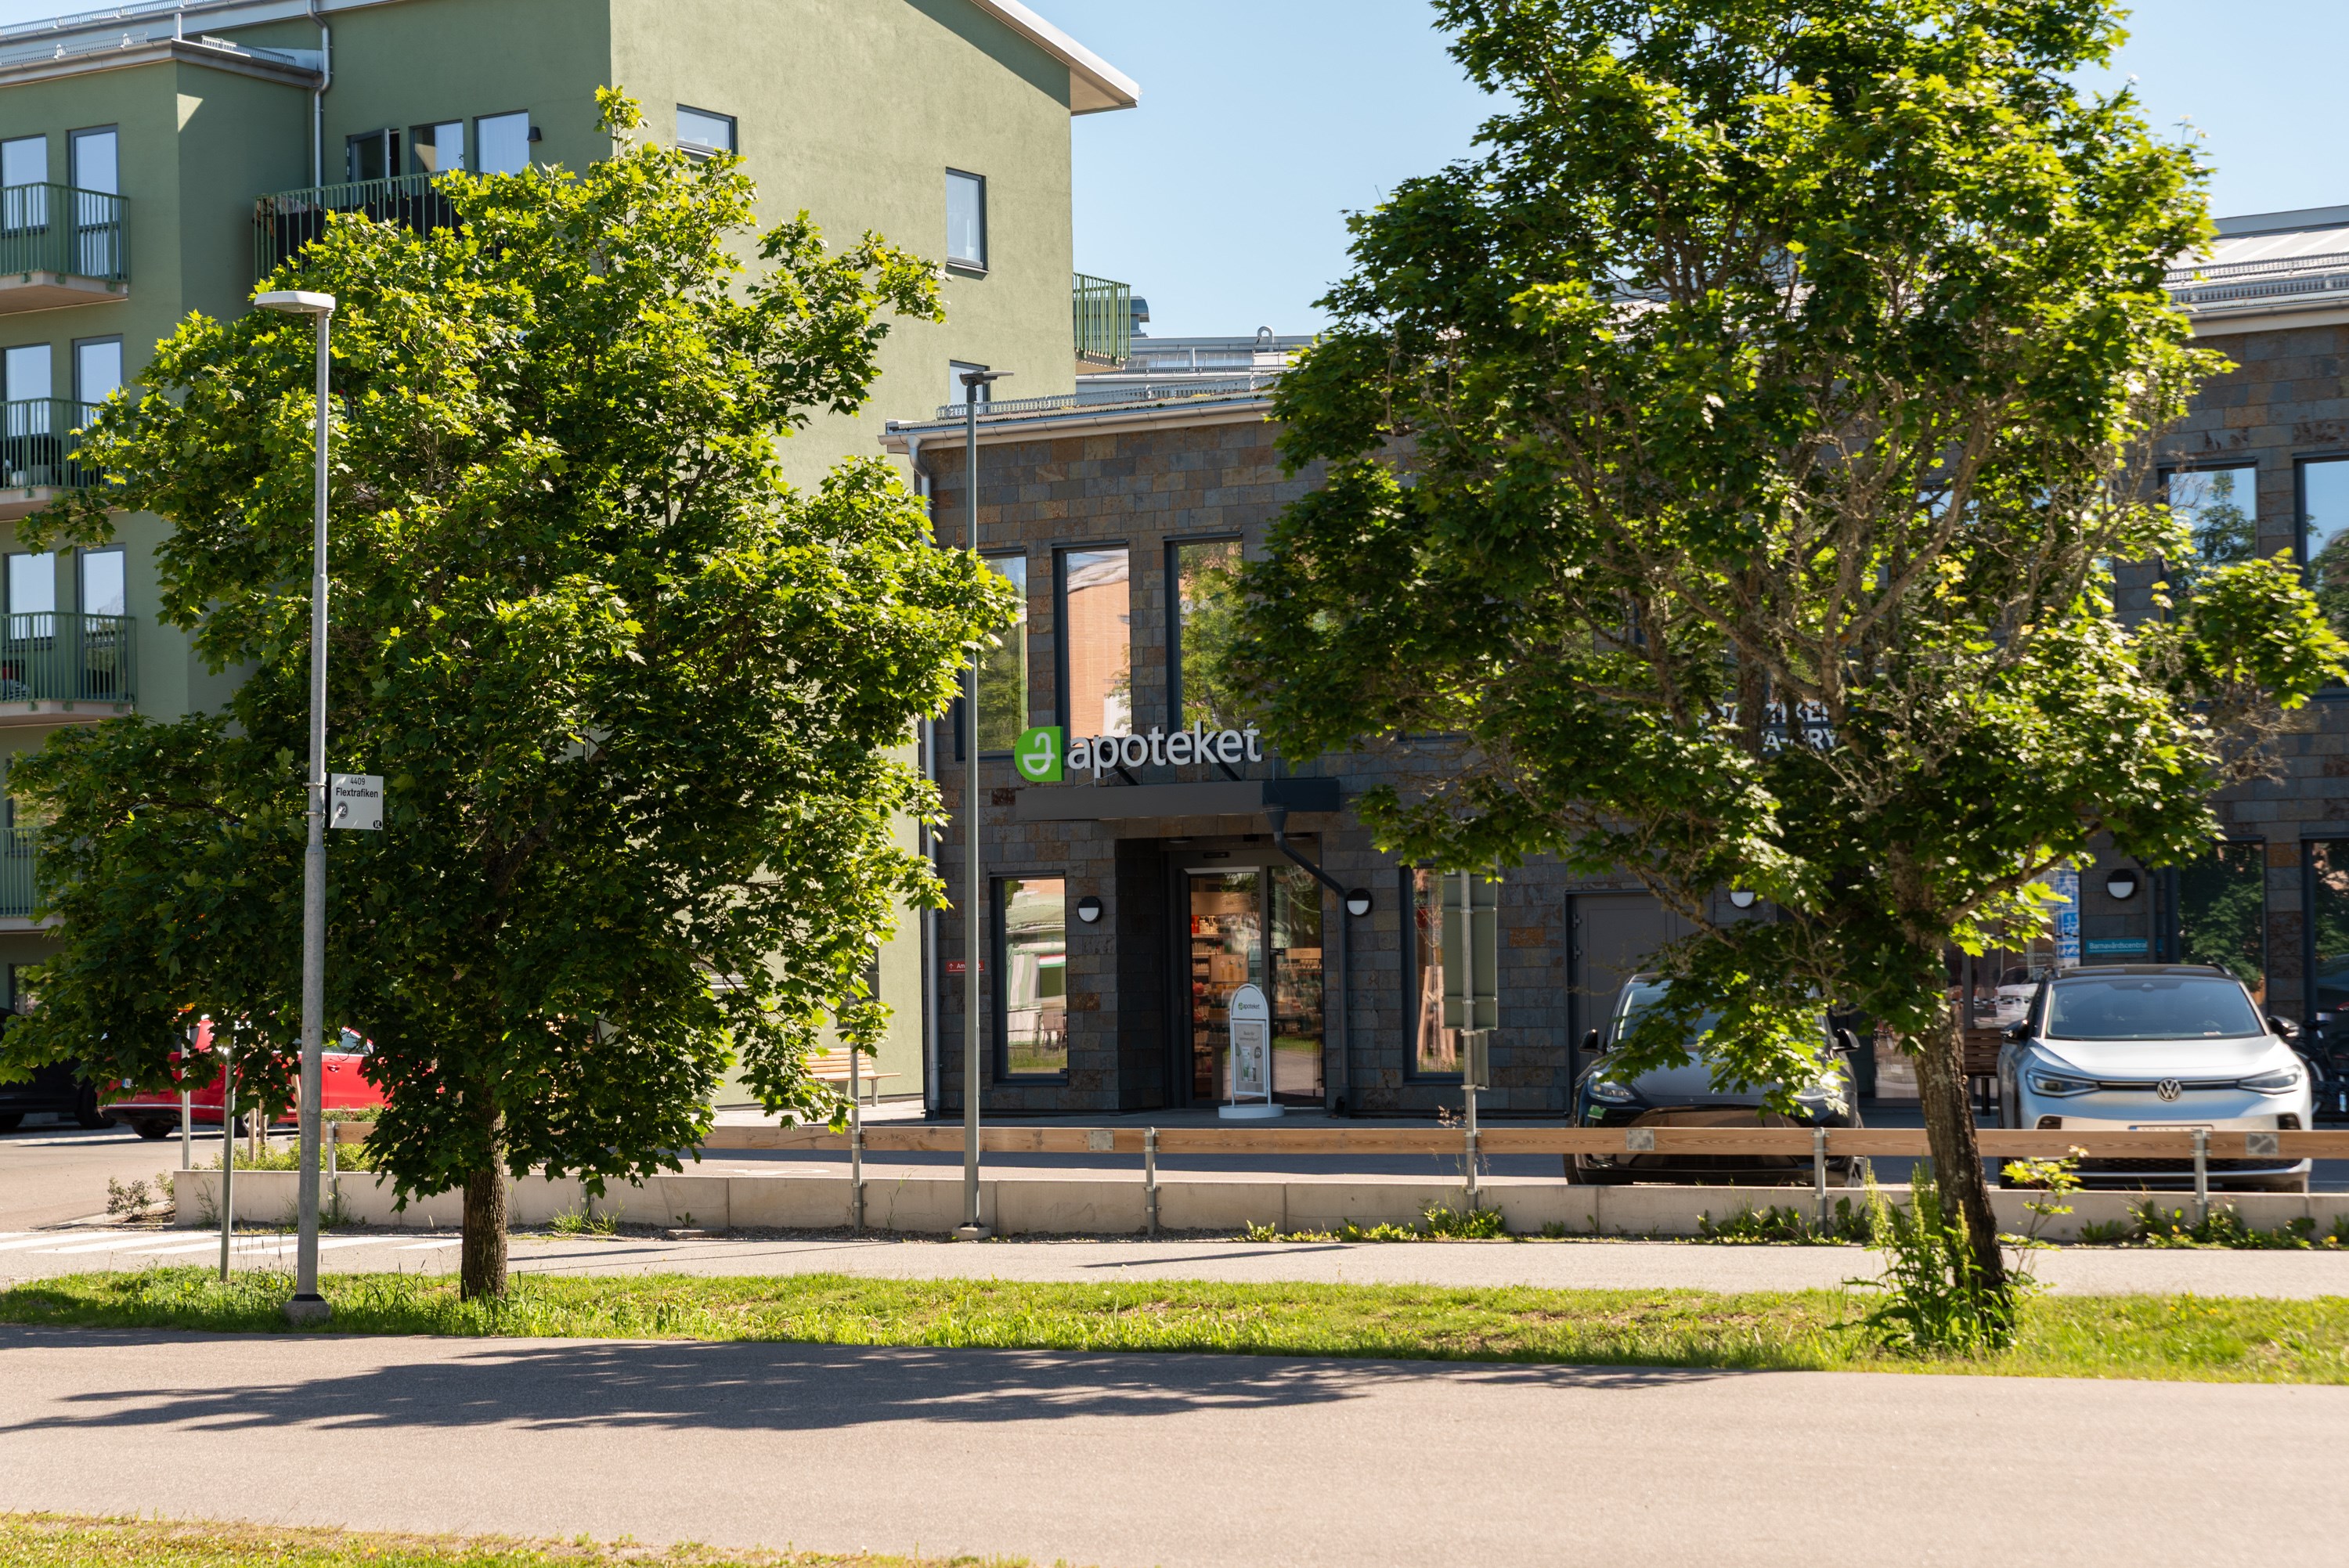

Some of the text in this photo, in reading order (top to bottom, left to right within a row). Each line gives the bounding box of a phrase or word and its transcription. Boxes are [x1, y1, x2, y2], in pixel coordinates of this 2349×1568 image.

[1067, 720, 1263, 779] apoteket
[350, 777, 366, 785] 4409
[335, 787, 379, 798] Flextrafiken
